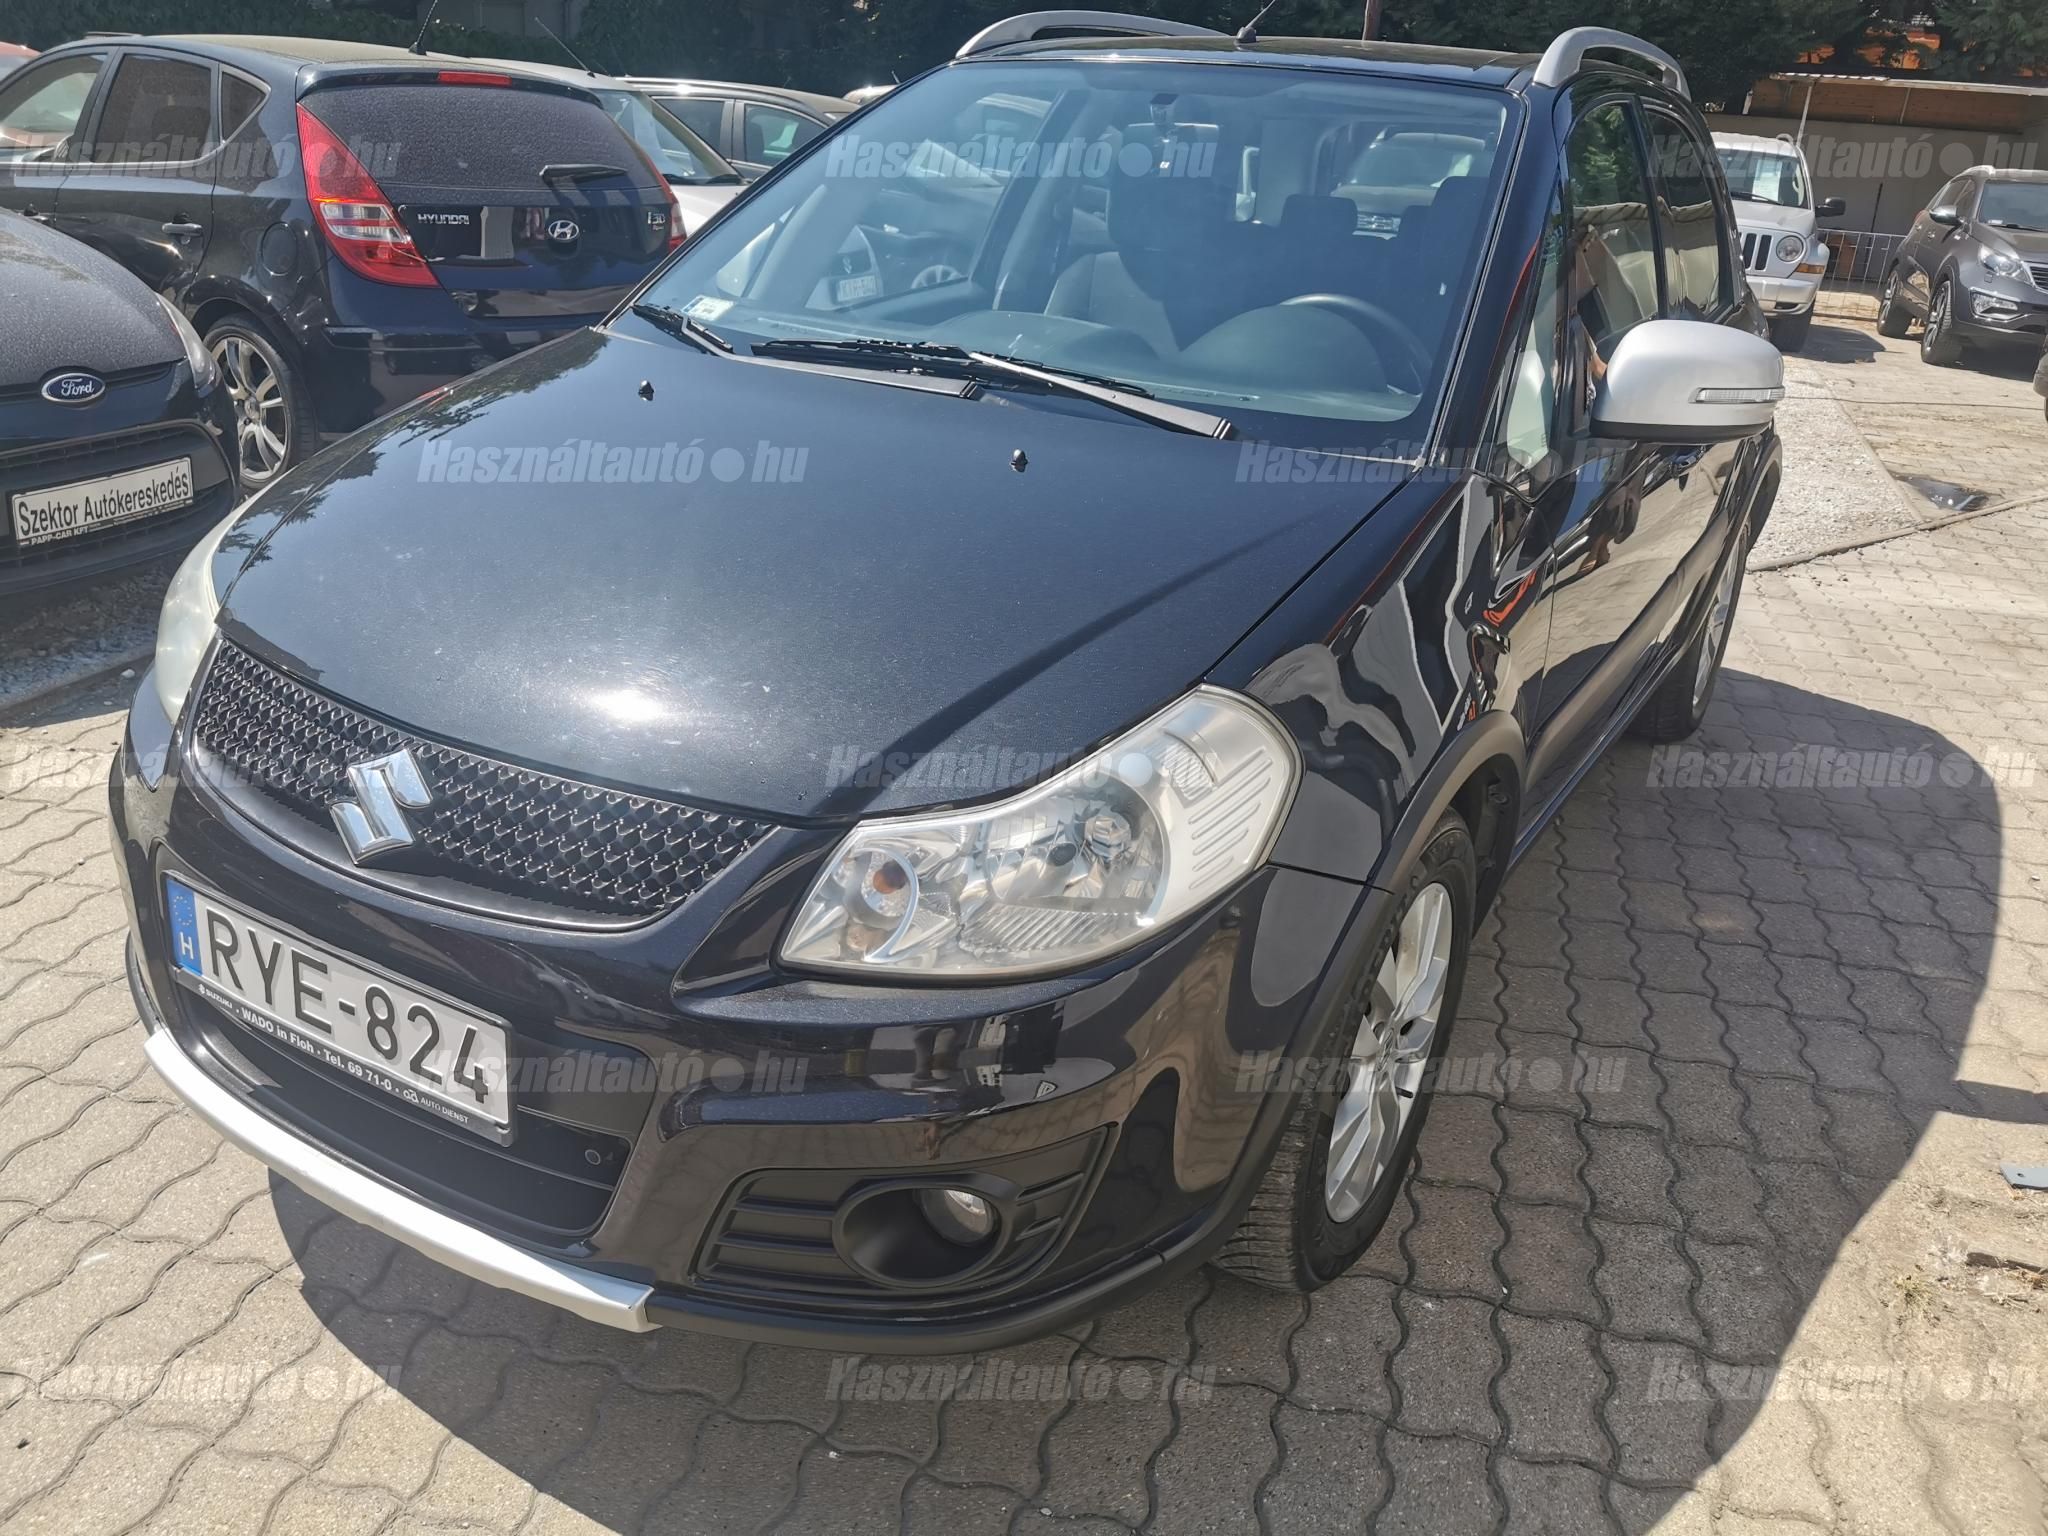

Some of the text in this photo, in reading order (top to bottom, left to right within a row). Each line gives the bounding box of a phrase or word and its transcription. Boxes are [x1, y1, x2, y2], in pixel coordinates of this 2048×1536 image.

[417, 213, 470, 225] HYUNDAI
[61, 377, 95, 397] Ford
[18, 501, 79, 536] Szektor
[84, 466, 189, 522] Autókereskedés
[31, 526, 89, 546] PAPP-CAR KFT
[180, 931, 195, 960] H
[206, 907, 489, 1104] RYE-824
[205, 988, 233, 1009] SUZUKI
[241, 1006, 274, 1032] WADO
[276, 1025, 288, 1041] in
[290, 1032, 314, 1054] Floh
[323, 1048, 345, 1068] Tel.
[347, 1061, 363, 1076] 69
[366, 1069, 392, 1091] 71-0
[420, 1097, 441, 1111] AUTO
[442, 1106, 469, 1124] DIENST
